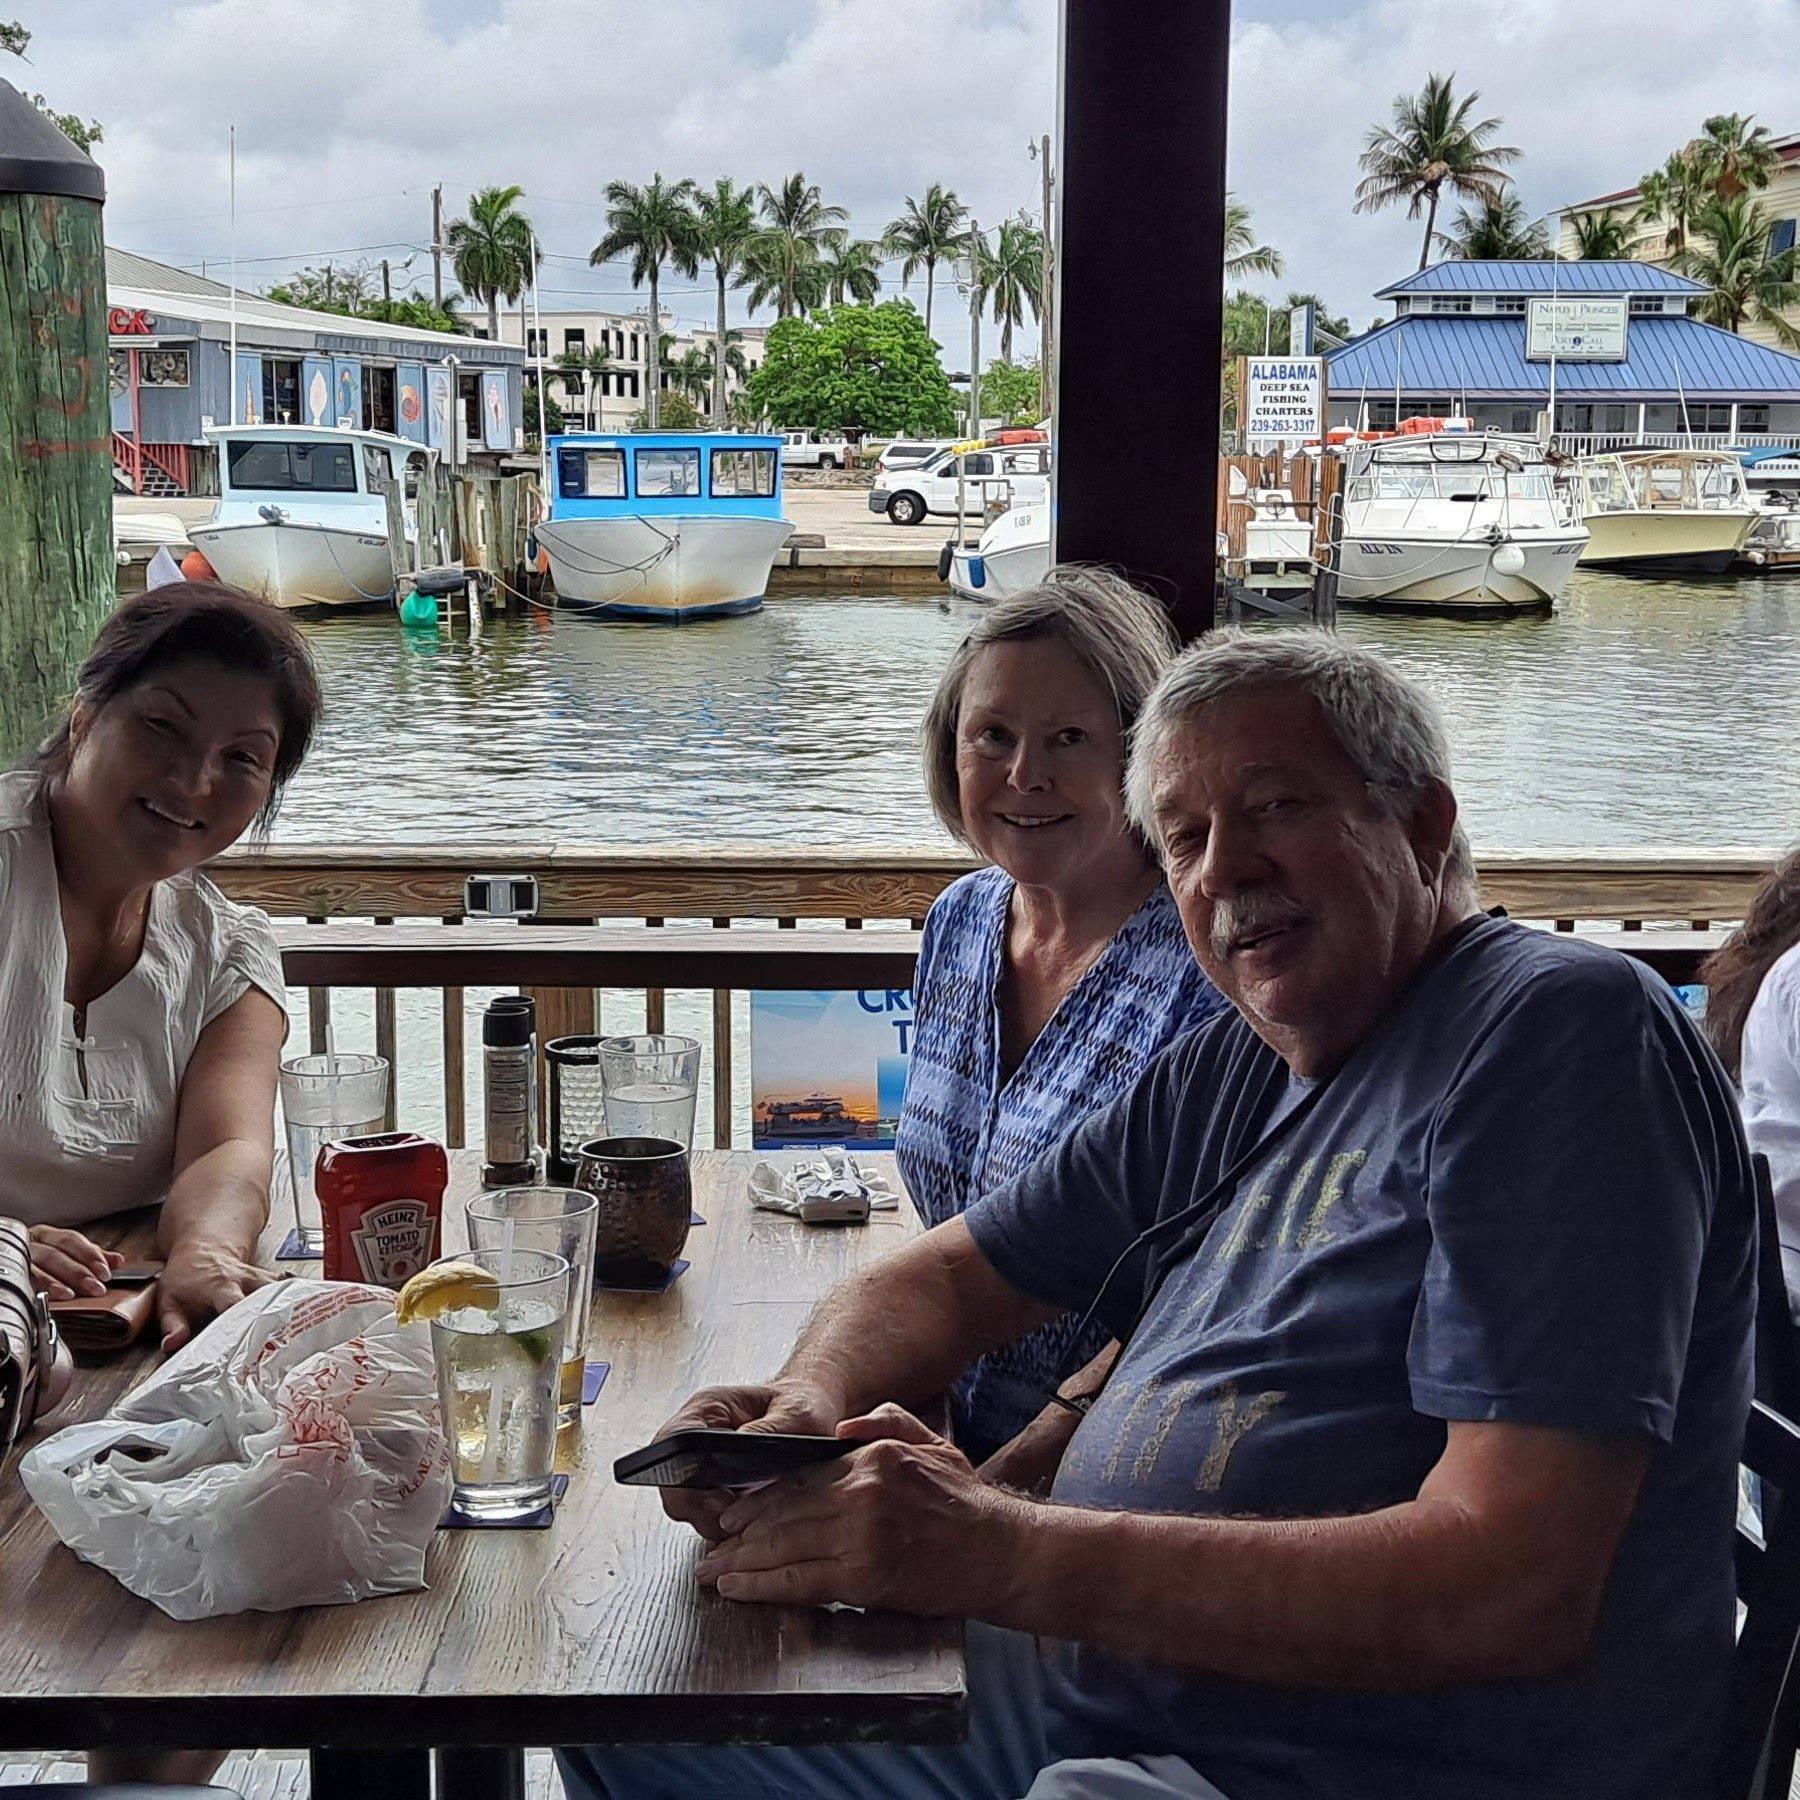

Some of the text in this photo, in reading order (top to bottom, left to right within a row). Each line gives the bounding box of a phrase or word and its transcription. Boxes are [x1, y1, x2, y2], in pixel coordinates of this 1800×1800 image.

[1252, 364, 1317, 380] ALABAMA
[1260, 383, 1310, 391] DEEP SEA
[1262, 395, 1307, 403] FISHING
[1255, 407, 1313, 415] CHARTERS
[1251, 420, 1315, 431] 239-263-3317
[1359, 543, 1384, 554] ALL
[858, 989, 914, 1013] CR
[377, 1211, 415, 1228] HEINZ
[376, 1230, 420, 1247] TOMATO
